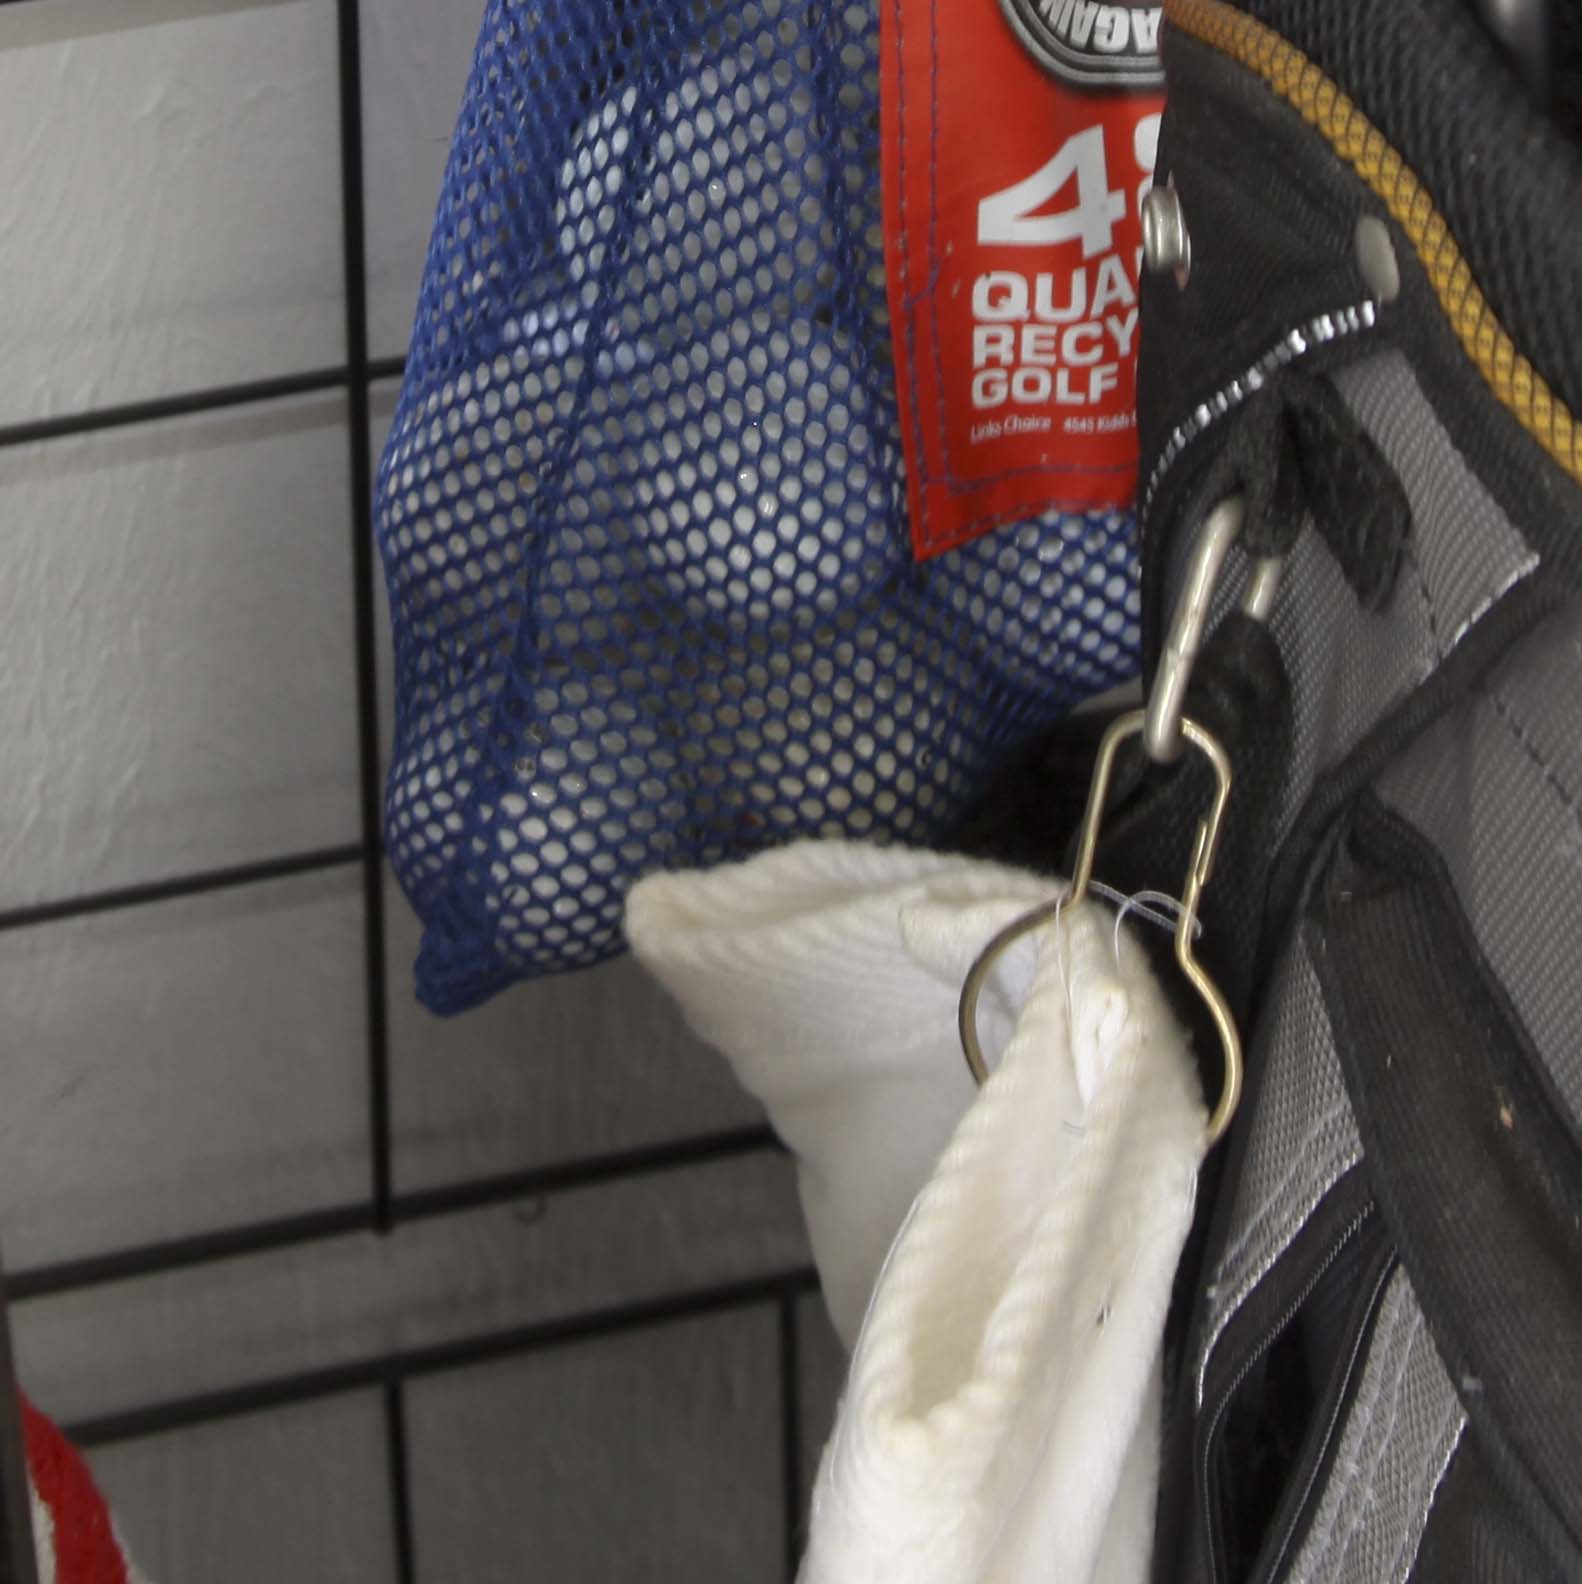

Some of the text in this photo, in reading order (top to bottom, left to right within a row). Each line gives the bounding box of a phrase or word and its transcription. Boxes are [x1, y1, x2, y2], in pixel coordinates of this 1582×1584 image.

[972, 248, 1143, 322] QUA
[970, 365, 1120, 410] GOLF
[1003, 414, 1051, 436] Choice
